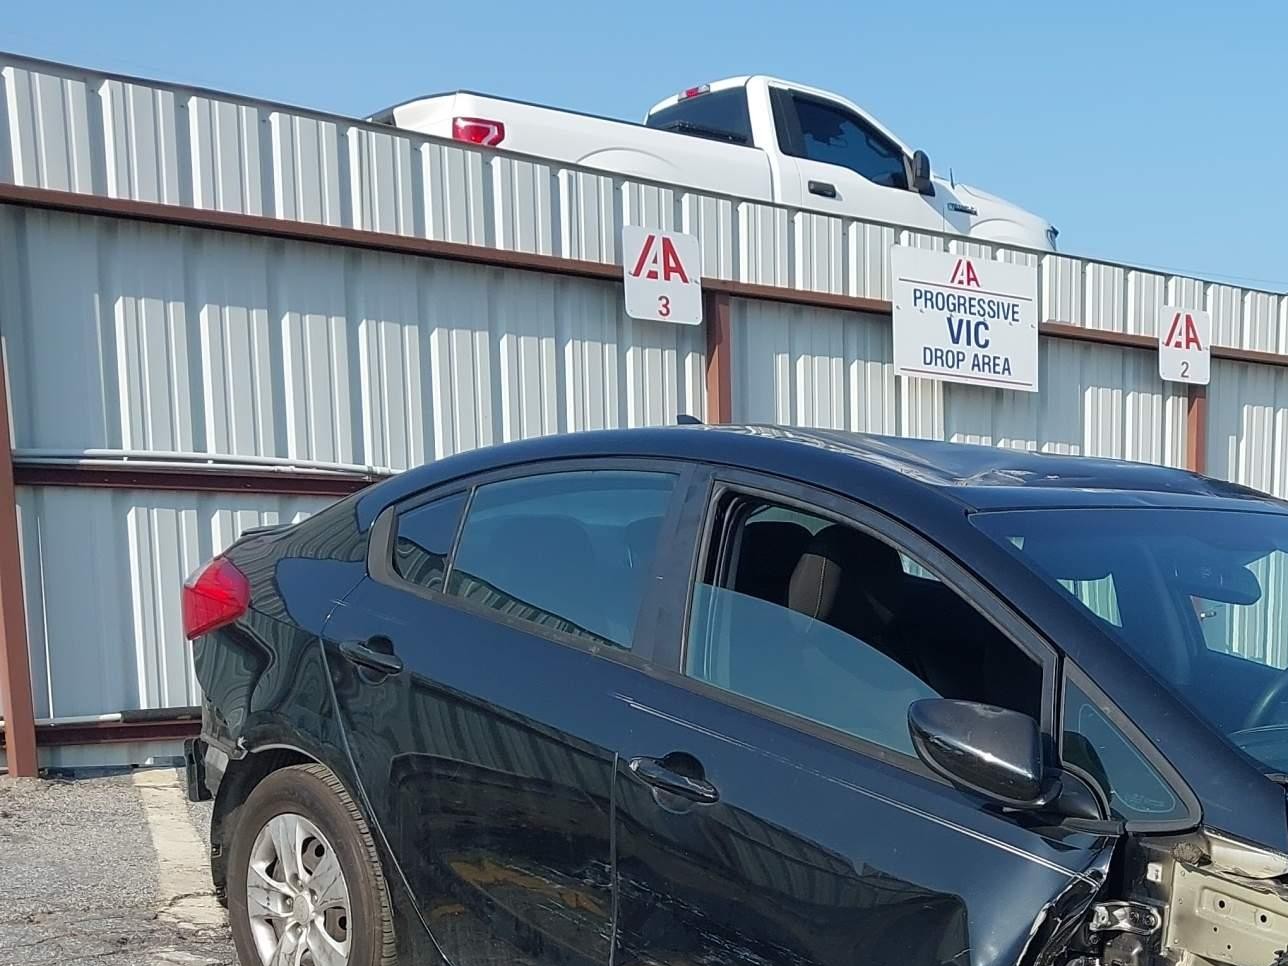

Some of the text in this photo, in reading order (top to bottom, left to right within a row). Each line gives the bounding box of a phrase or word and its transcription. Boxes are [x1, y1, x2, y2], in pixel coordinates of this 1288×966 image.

[658, 295, 670, 317] 3
[913, 288, 1020, 322] PROGRESSIVE
[946, 317, 990, 349] VIC
[923, 346, 1012, 376] DROP AREA
[1180, 361, 1190, 378] 2
